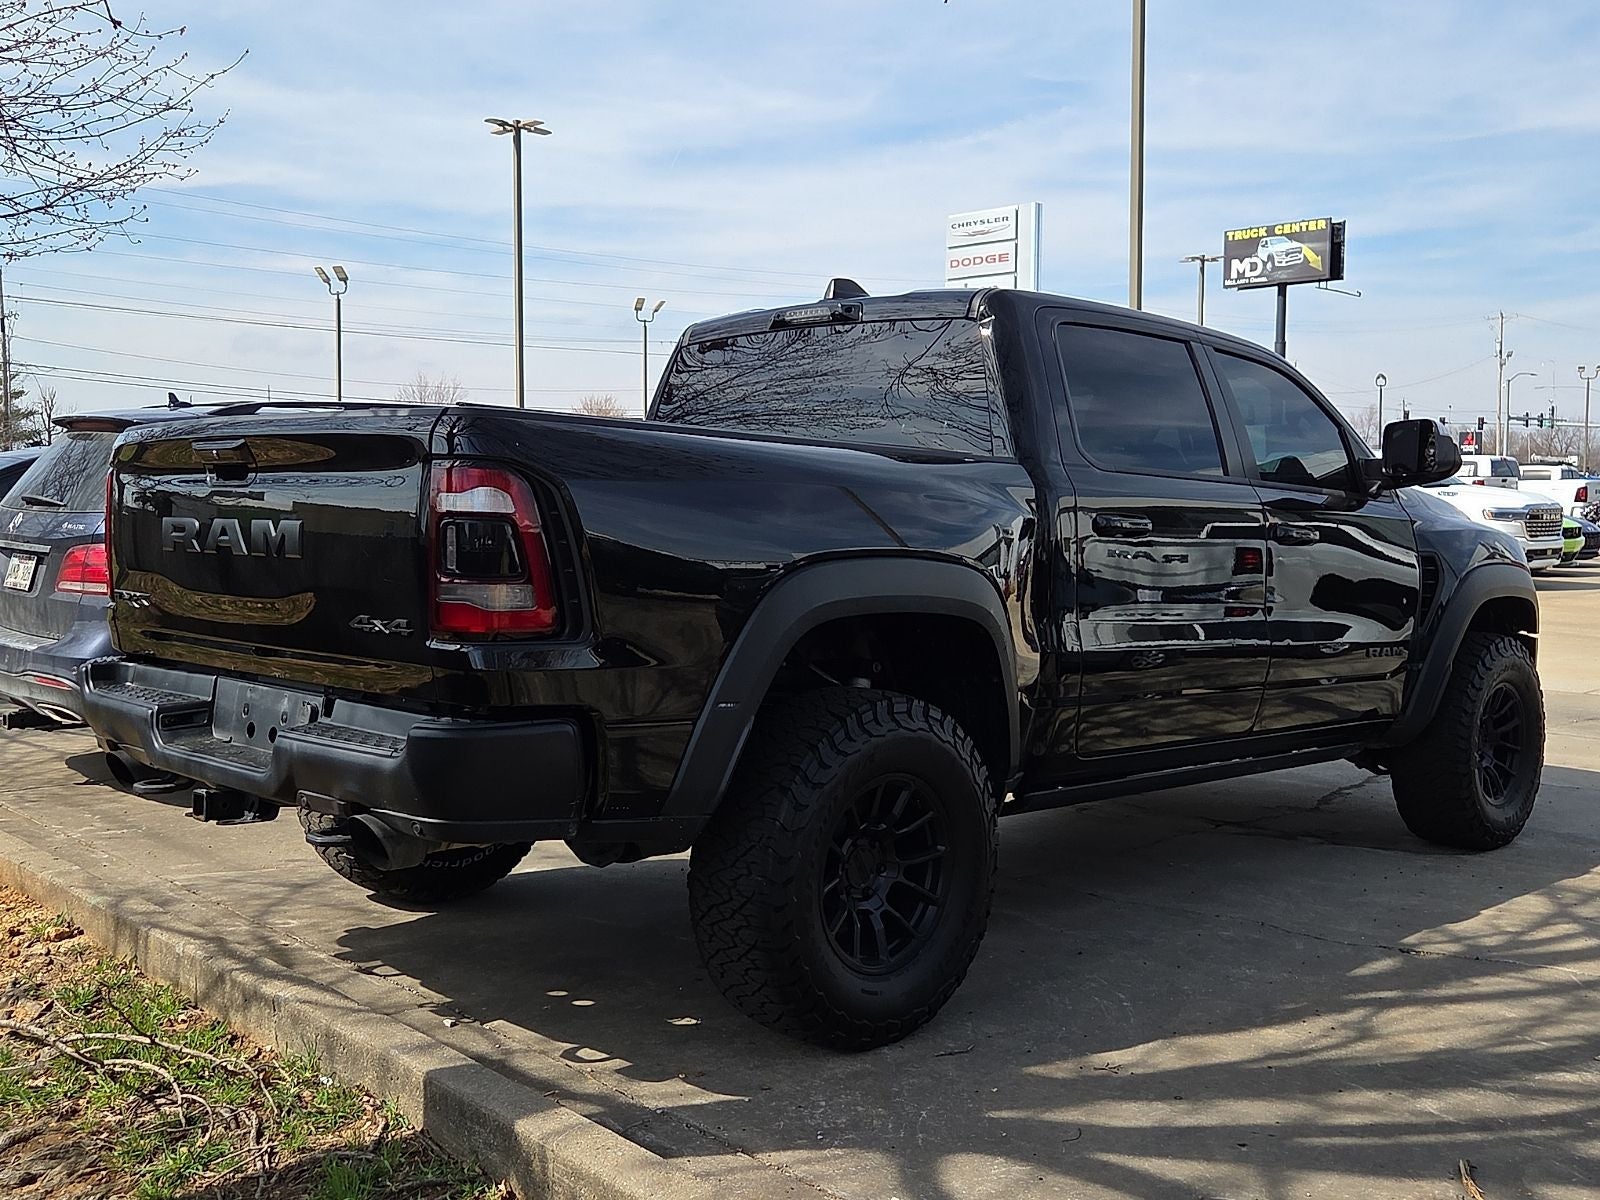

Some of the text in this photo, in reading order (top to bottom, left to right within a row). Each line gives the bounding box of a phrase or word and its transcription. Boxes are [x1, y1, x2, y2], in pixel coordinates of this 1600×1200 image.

[951, 216, 1009, 229] CHRYSLER
[1226, 219, 1327, 241] TRUCK CENTER
[950, 253, 1010, 269] DODGE
[1230, 257, 1263, 279] MD
[161, 516, 304, 559] RAM
[1369, 646, 1405, 657] RAM
